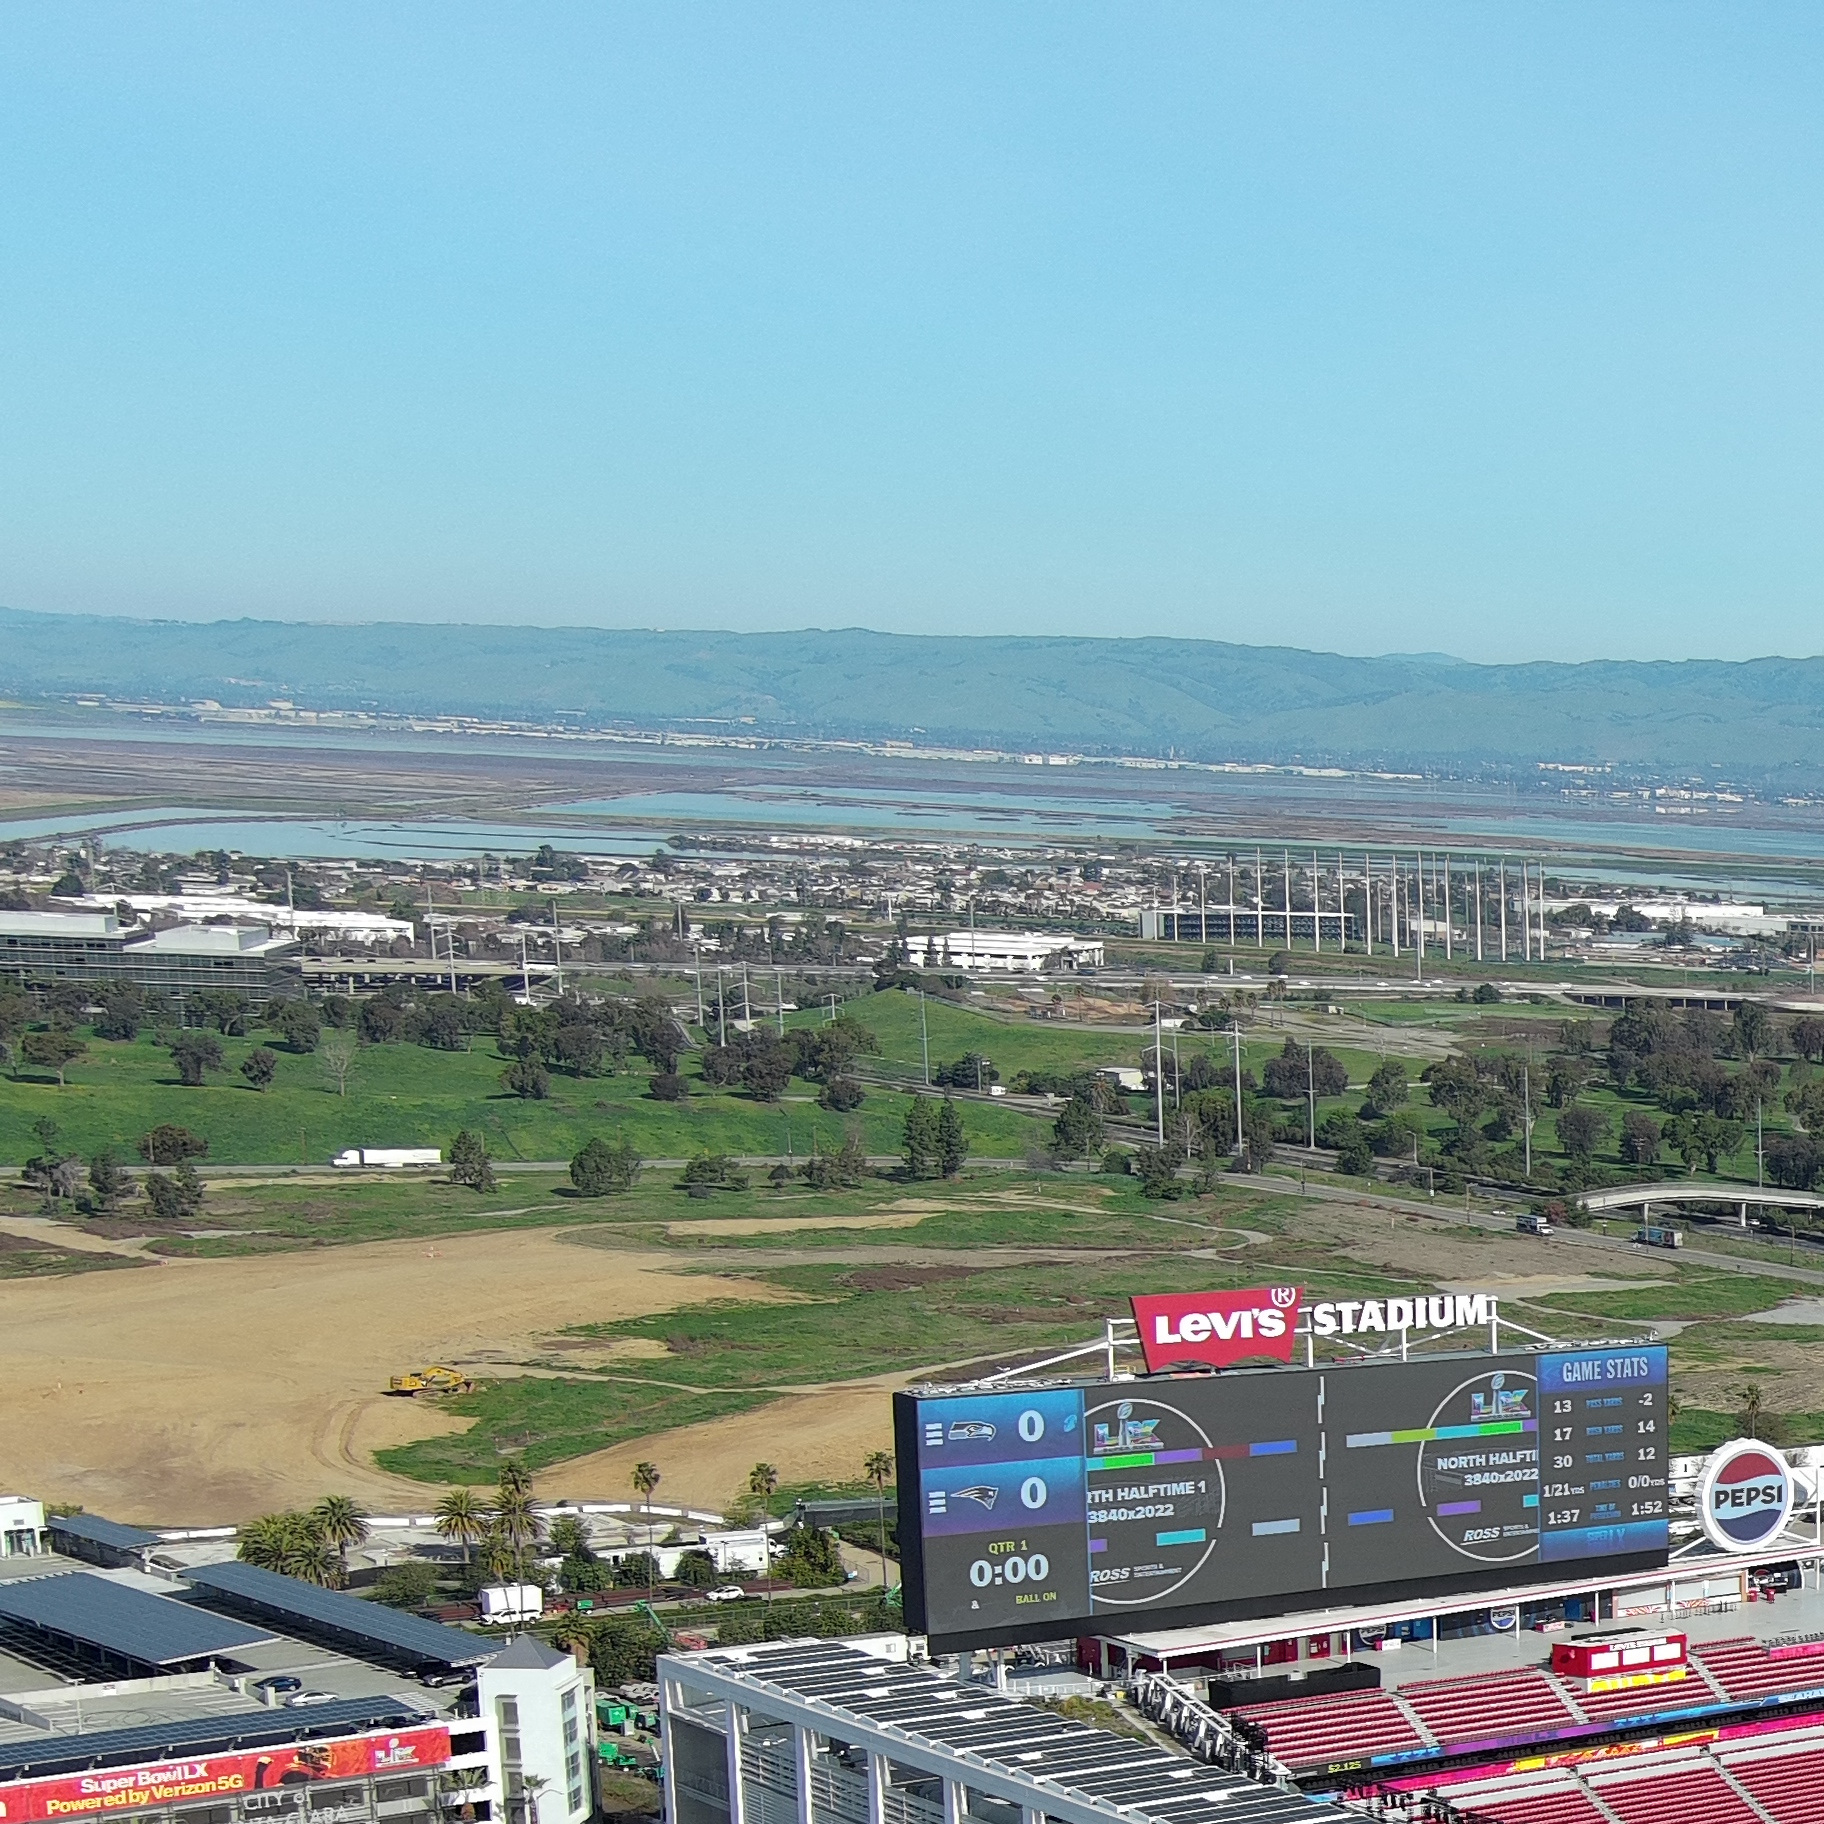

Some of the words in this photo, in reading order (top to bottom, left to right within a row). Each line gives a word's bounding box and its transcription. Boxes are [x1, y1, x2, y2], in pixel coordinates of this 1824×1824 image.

[1155, 1308, 1286, 1344] Levi's
[1312, 1294, 1488, 1335] STADIUM
[1562, 1361, 1601, 1382] GAME
[1606, 1357, 1648, 1379] STATS
[1554, 1400, 1572, 1414] 13
[1638, 1393, 1653, 1407] -2
[1018, 1410, 1045, 1442] 0
[1554, 1427, 1573, 1441] 17
[1637, 1420, 1655, 1433] 14
[1437, 1452, 1486, 1470] NORTH
[1489, 1449, 1539, 1466] HALFTI
[1553, 1455, 1573, 1469] 30
[1638, 1447, 1656, 1461] 12
[1464, 1468, 1539, 1486] 3840x2022
[1020, 1476, 1047, 1509] 0
[1117, 1482, 1195, 1503] HALFTIME
[1198, 1480, 1206, 1493] 1
[1714, 1484, 1783, 1510] PEPSI
[1087, 1504, 1174, 1524] 3840x2022
[1548, 1509, 1580, 1525] 1:37
[1631, 1501, 1663, 1516] 1:52
[1463, 1527, 1501, 1541] ROSS
[989, 1541, 1015, 1555] QTR
[1021, 1540, 1028, 1551] 1
[969, 1553, 1049, 1587] 0:00
[1090, 1566, 1131, 1583] ROSS
[1016, 1593, 1041, 1605] BALL
[1043, 1592, 1057, 1602] ON
[81, 1774, 135, 1796] Super
[138, 1766, 181, 1789] Bowl
[183, 1763, 208, 1780] LX
[47, 1789, 122, 1815] Powered
[128, 1787, 149, 1807] by
[153, 1780, 215, 1801] Verizon
[217, 1774, 243, 1790] 5G
[244, 1790, 284, 1810] CITY
